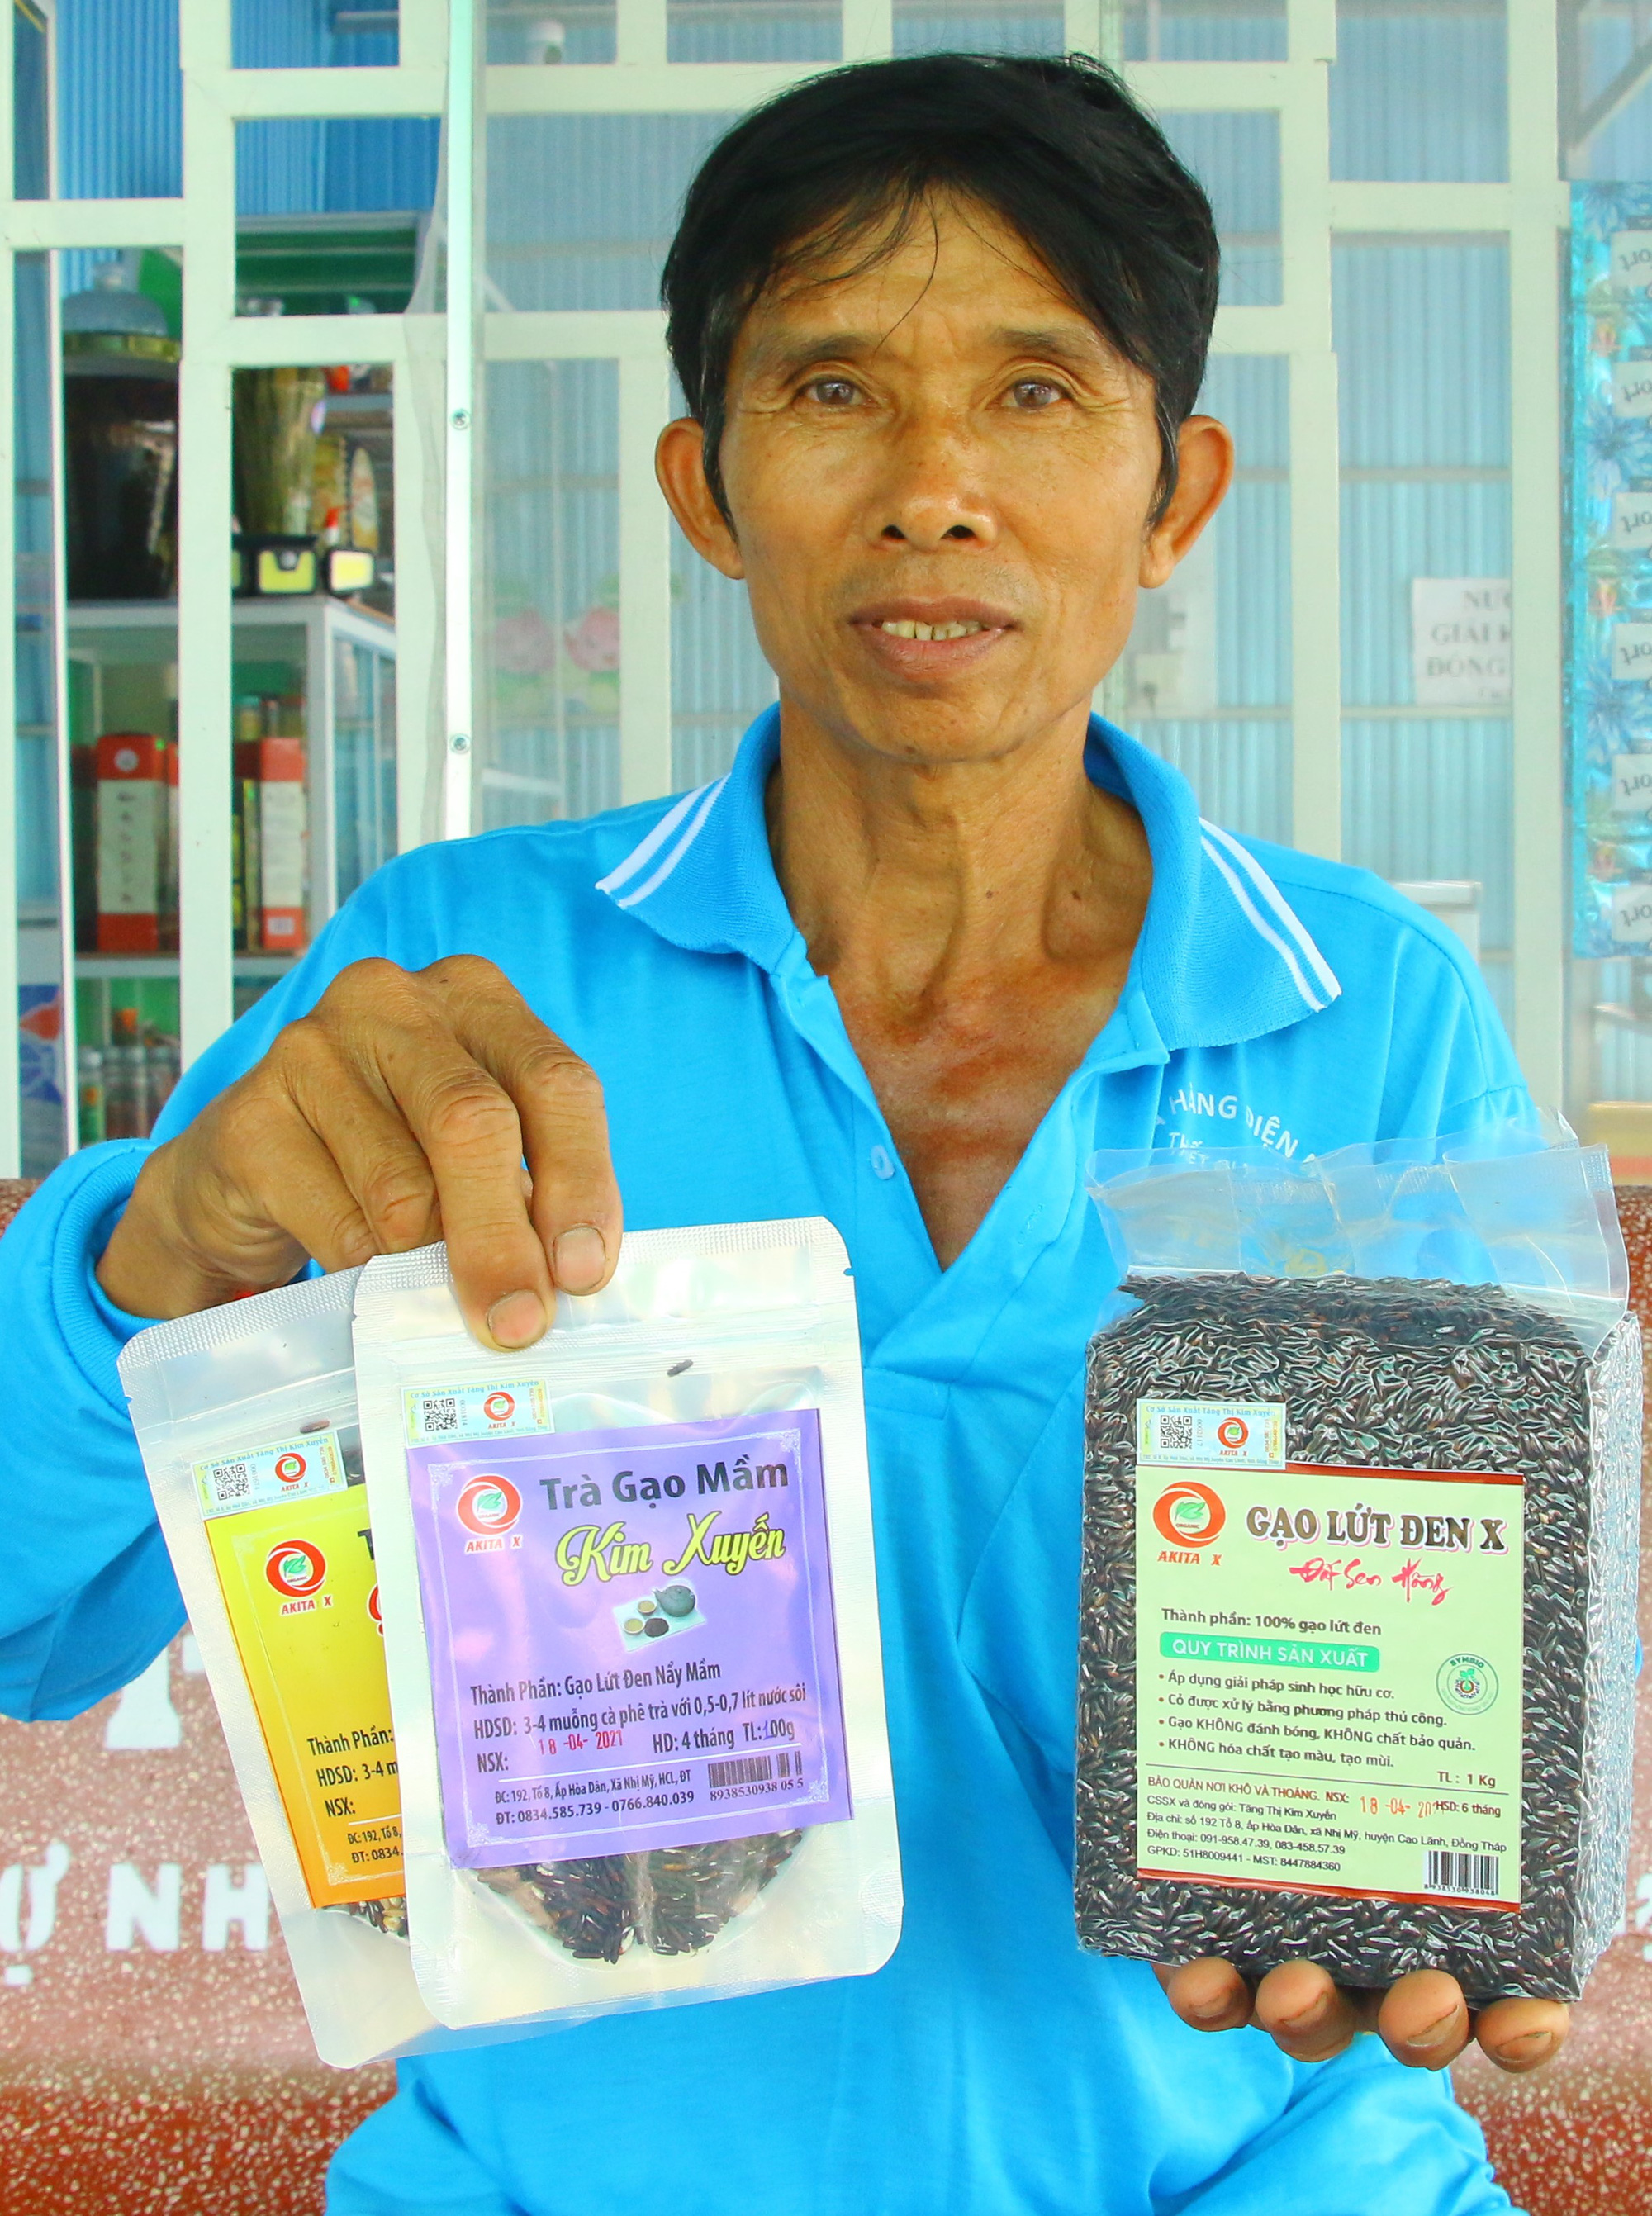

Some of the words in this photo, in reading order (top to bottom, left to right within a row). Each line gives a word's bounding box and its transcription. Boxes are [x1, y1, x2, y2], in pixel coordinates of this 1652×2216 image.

[539, 1474, 601, 1510] Trà
[612, 1471, 686, 1509] Gạo
[696, 1454, 788, 1495] Mầm
[1247, 1507, 1317, 1546] GẠO
[1327, 1503, 1391, 1544] LỨT
[1400, 1515, 1470, 1549] ĐEN
[1480, 1519, 1505, 1550] X
[467, 1539, 503, 1552] AKITA
[555, 1521, 652, 1586] Kim
[662, 1511, 786, 1576] Xuyến
[1158, 1551, 1200, 1564] AKITA
[282, 1600, 315, 1614] AKITA
[1161, 1608, 1206, 1623] Thành
[1256, 1616, 1296, 1629] 100%
[1298, 1621, 1327, 1634] gạo
[1330, 1620, 1350, 1633] lứt
[1353, 1621, 1381, 1635] đen
[1173, 1639, 1211, 1655] QUY
[1218, 1639, 1272, 1660] TRÌNH
[1278, 1644, 1313, 1663] SẢN
[1320, 1648, 1369, 1667] XUẤT
[470, 1682, 515, 1706] Thành
[520, 1677, 562, 1700] Phần:
[564, 1676, 593, 1698] Gạo
[596, 1672, 620, 1692] Lứt
[623, 1669, 652, 1689] Đen
[686, 1658, 720, 1682] Mầm
[1168, 1669, 1185, 1686] Áp
[1189, 1673, 1221, 1688] dụng
[1225, 1676, 1248, 1689] giải
[1251, 1678, 1284, 1693] pháp
[1288, 1681, 1315, 1693] sinh
[1319, 1683, 1342, 1697] học
[1346, 1685, 1372, 1697] hữu
[1376, 1690, 1394, 1699] cơ.
[474, 1717, 517, 1739] HDSD:
[525, 1715, 546, 1734] 3-4
[549, 1708, 598, 1731] muỗng
[601, 1706, 616, 1725] cà
[620, 1702, 645, 1727] phê
[648, 1701, 668, 1720] trà
[671, 1697, 691, 1717] với
[694, 1692, 738, 1716] 0,5-0,7
[742, 1690, 756, 1708] lít
[759, 1687, 787, 1706] nước
[790, 1682, 805, 1702] sôi
[1188, 1696, 1218, 1710] được
[1222, 1697, 1239, 1710] xử
[1242, 1700, 1254, 1713] lý
[1258, 1700, 1290, 1716] bằng
[1294, 1704, 1343, 1720] phương
[1347, 1708, 1380, 1723] pháp
[1384, 1711, 1408, 1723] thủ
[1412, 1712, 1447, 1728] công.
[306, 1733, 350, 1756] Thành
[351, 1725, 394, 1749] Phần:
[653, 1733, 679, 1753] HD:
[681, 1731, 691, 1749] 4
[693, 1727, 734, 1749] tháng
[1169, 1716, 1193, 1730] Gạo
[1197, 1717, 1243, 1733] KHÔNG
[1247, 1723, 1280, 1735] đánh
[1284, 1725, 1320, 1741] bóng,
[1324, 1727, 1373, 1743] KHÔNG
[1376, 1732, 1406, 1745] chất
[1410, 1734, 1434, 1747] bảo
[1438, 1737, 1475, 1751] quản.
[477, 1751, 509, 1773] NSX:
[1169, 1738, 1214, 1753] KHÔNG
[1219, 1743, 1242, 1754] hóa
[1246, 1744, 1275, 1758] chất
[1279, 1749, 1300, 1761] tạo
[1304, 1750, 1336, 1763] màu,
[1340, 1753, 1362, 1766] tạo
[1366, 1755, 1393, 1767] mùi.
[316, 1765, 358, 1787] HDSD:
[362, 1761, 384, 1780] 3-4
[1479, 1775, 1495, 1789] Kg
[1148, 1775, 1170, 1787] BẢO
[1173, 1777, 1203, 1791] QUẢN
[1206, 1782, 1226, 1792] NƠI
[1228, 1782, 1251, 1795] KHÔ
[1254, 1784, 1270, 1796] VÀ
[1271, 1787, 1320, 1801] THOÁNG.
[1326, 1791, 1349, 1803] NSX:
[325, 1797, 355, 1817] NSX:
[496, 1811, 515, 1825] ĐT:
[518, 1802, 601, 1822] 0834.585.739
[612, 1791, 694, 1812] 0766.840.039
[1147, 1796, 1176, 1806] CSSX
[1193, 1800, 1216, 1812] đóng
[1219, 1802, 1236, 1813] gói:
[1239, 1803, 1264, 1816] Tăng
[1266, 1806, 1281, 1817] Thị
[1284, 1807, 1303, 1817] Kim
[1435, 1801, 1459, 1812] HSD:
[1462, 1803, 1469, 1813] 6
[1471, 1804, 1501, 1818] tháng
[1147, 1812, 1163, 1823] Địa
[1165, 1815, 1182, 1823] chỉ:
[1185, 1815, 1197, 1825] số
[1200, 1817, 1217, 1827] 192
[1246, 1820, 1260, 1832] ấp
[1262, 1823, 1282, 1833] Hòa
[1284, 1825, 1308, 1836] Dân,
[1325, 1828, 1341, 1839] Nhị
[1344, 1829, 1361, 1841] Mỹ,
[1365, 1832, 1394, 1844] huyện
[1398, 1834, 1418, 1844] Cao
[1421, 1836, 1449, 1848] Lãnh,
[1451, 1838, 1479, 1852] Đồng
[1481, 1841, 1507, 1853] Tháp
[1147, 1829, 1169, 1840] Điện
[1171, 1831, 1198, 1843] thoại:
[1200, 1834, 1272, 1850] 091-958.47.39,
[1275, 1840, 1346, 1854] 083-458.57.39
[351, 1851, 370, 1863] ĐT:
[1147, 1845, 1180, 1856] GPKD:
[1183, 1848, 1242, 1862] 51H8009441
[1253, 1855, 1277, 1865] MST:
[1280, 1858, 1341, 1872] 8447884360
[106, 1862, 269, 1951] NH
